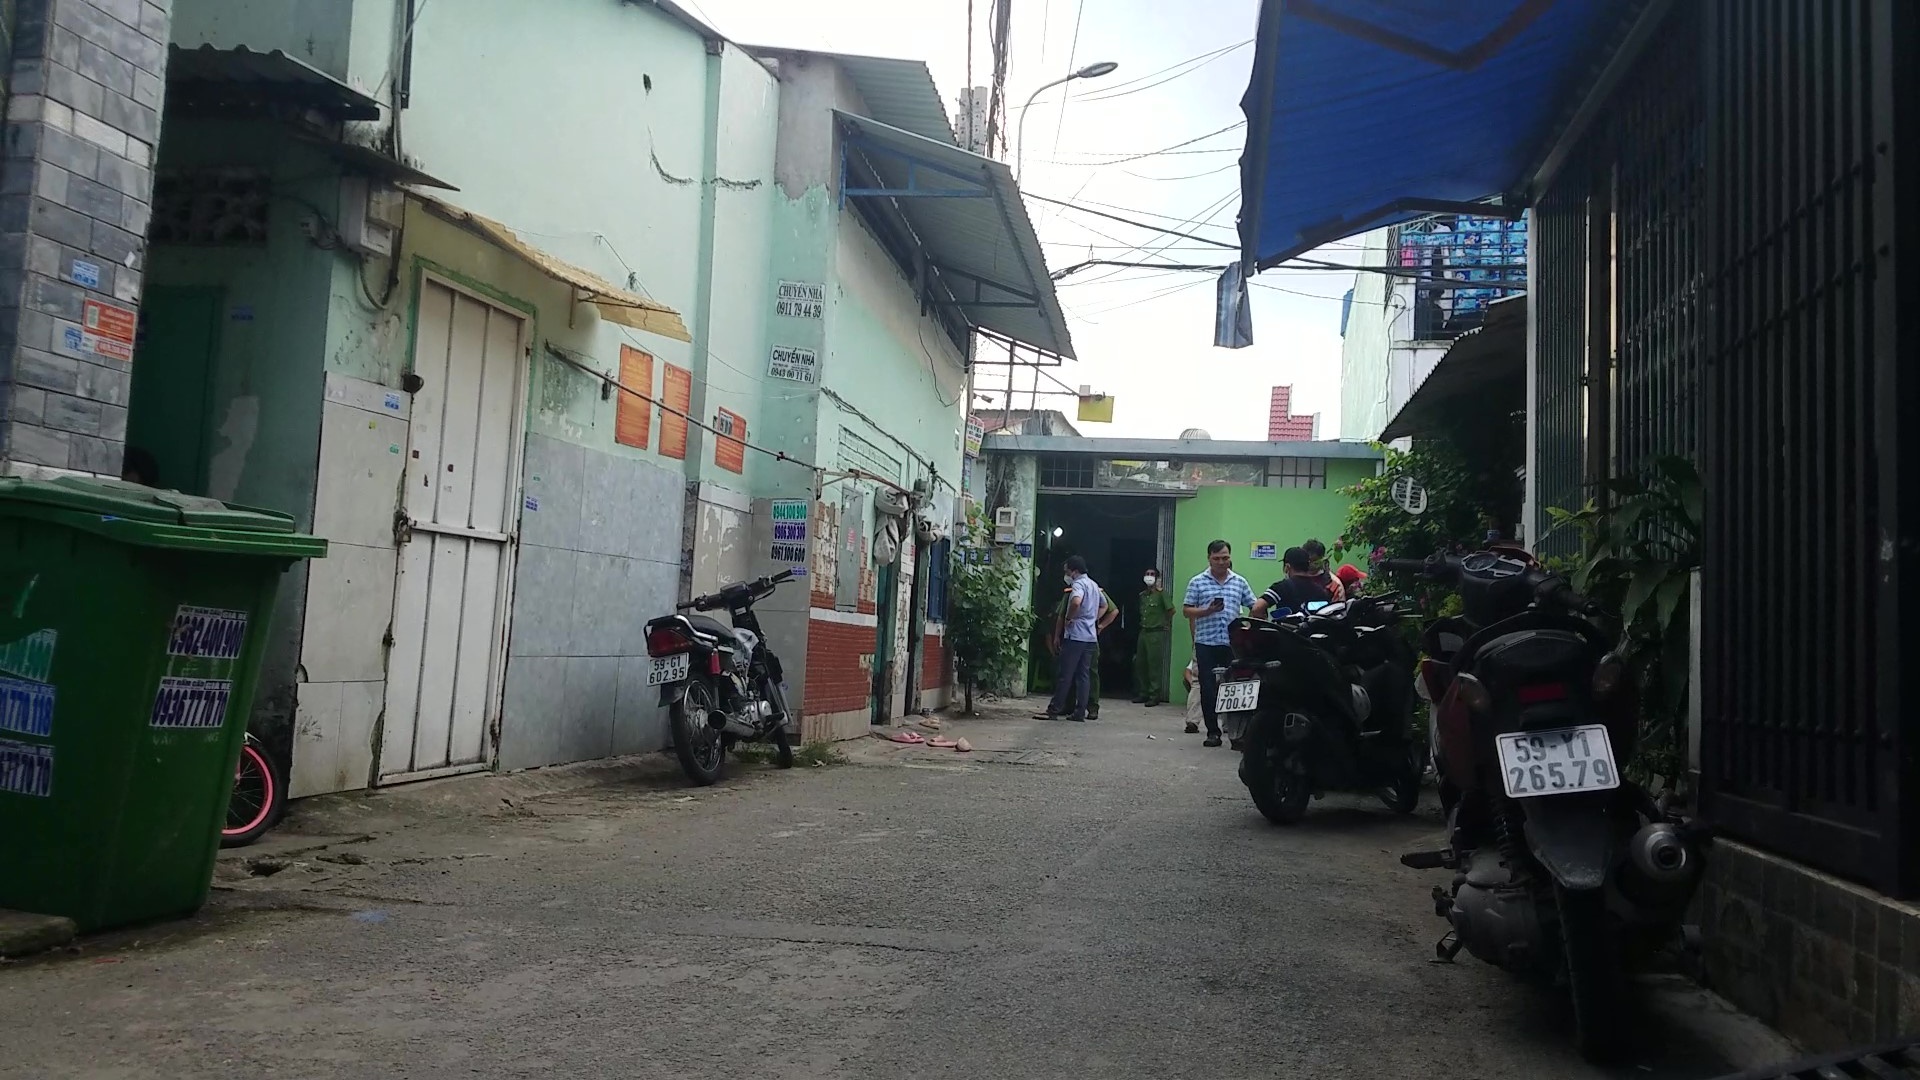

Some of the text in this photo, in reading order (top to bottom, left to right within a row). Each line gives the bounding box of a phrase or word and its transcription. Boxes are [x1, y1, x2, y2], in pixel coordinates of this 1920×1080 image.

[777, 301, 822, 318] 0911 79 44 39
[654, 656, 680, 671] 59-G1
[649, 667, 684, 683] 602.95
[1224, 683, 1254, 697] 59-Y3
[1219, 696, 1254, 711] 700.47
[1513, 731, 1591, 763] 59-Y1
[1509, 758, 1611, 793] 265.79
